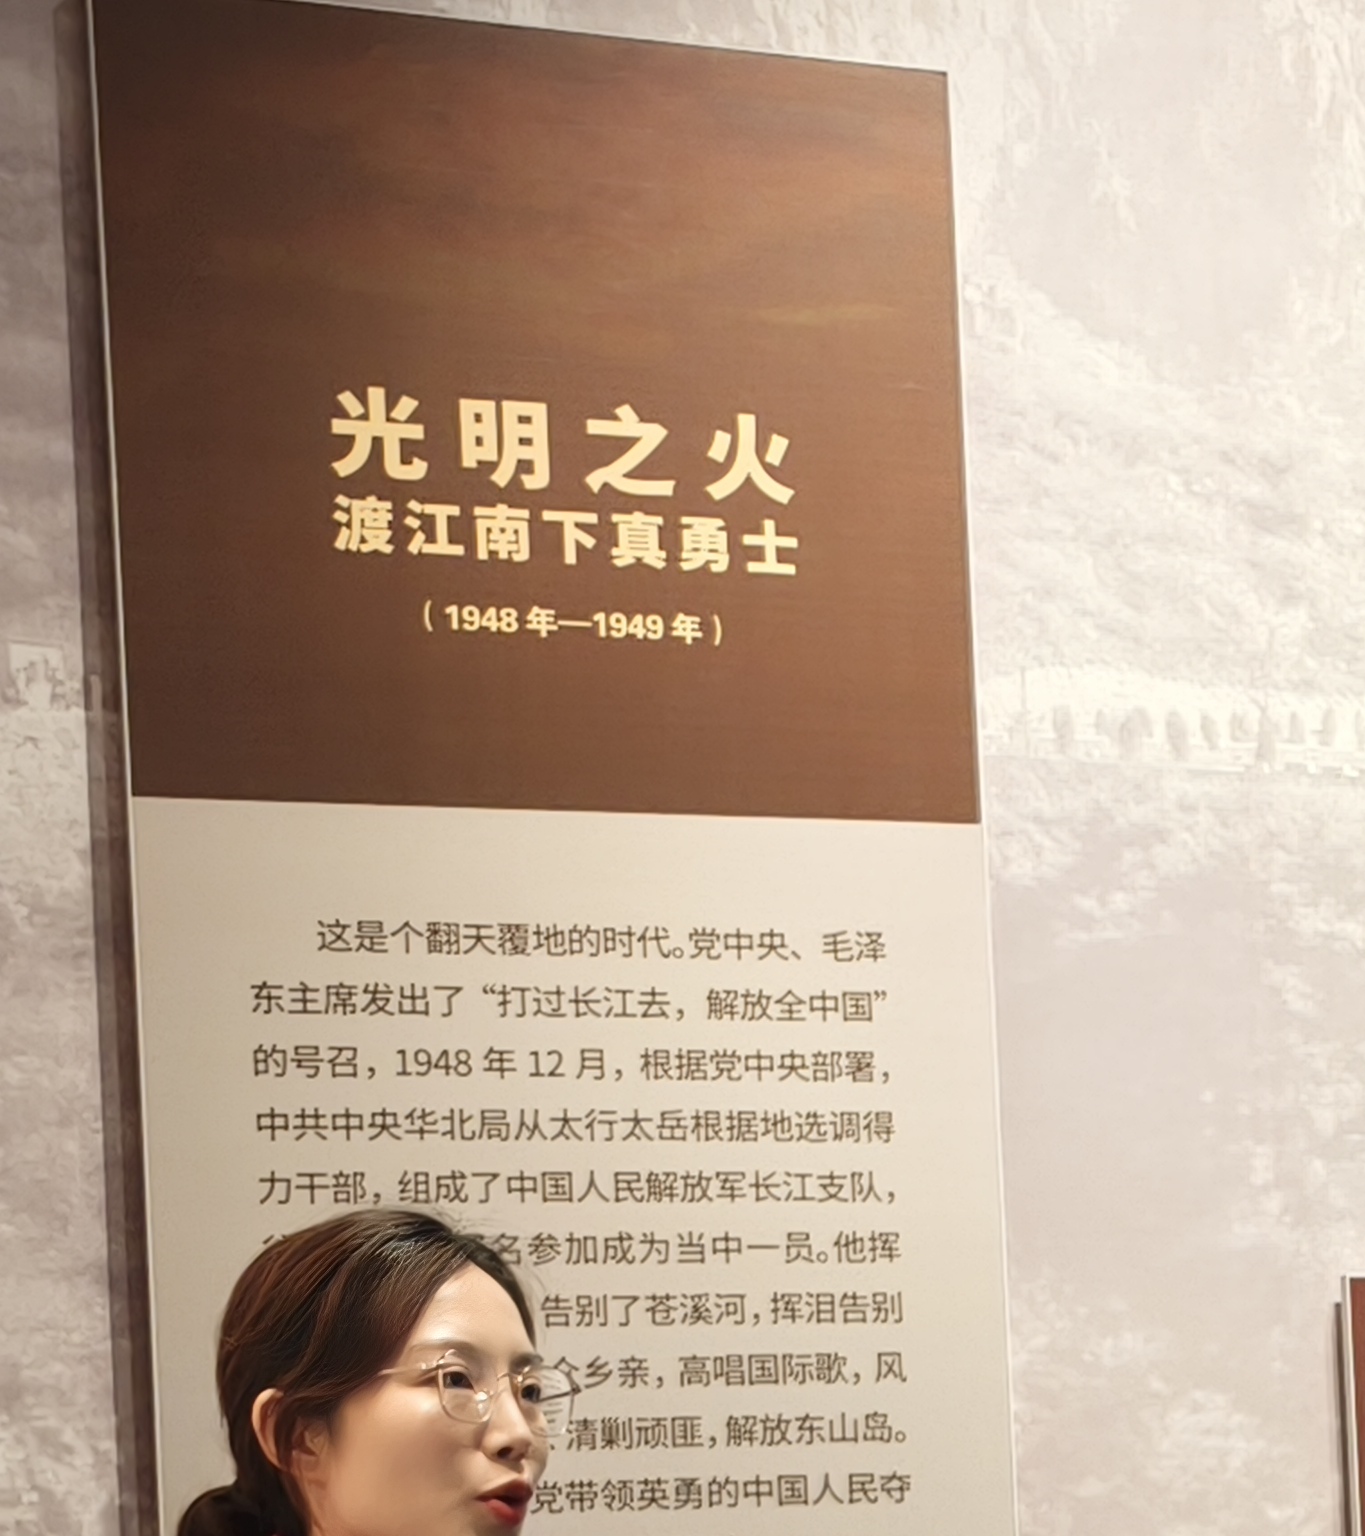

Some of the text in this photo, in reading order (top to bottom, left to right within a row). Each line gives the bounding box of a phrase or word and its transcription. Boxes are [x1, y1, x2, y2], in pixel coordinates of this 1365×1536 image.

[330, 386, 797, 504] 光明之火
[332, 494, 800, 577] 渡江南下真勇士
[255, 1107, 897, 1145] 中共中央华北局从太行太岳根据地选调得
[258, 1169, 898, 1206] 力干部，组成了中国人民解放军长江支队，
[540, 1291, 904, 1329] 告别了苍溪河，挥泪告别
[530, 1470, 912, 1515] 党带领英勇的中国人民夺
